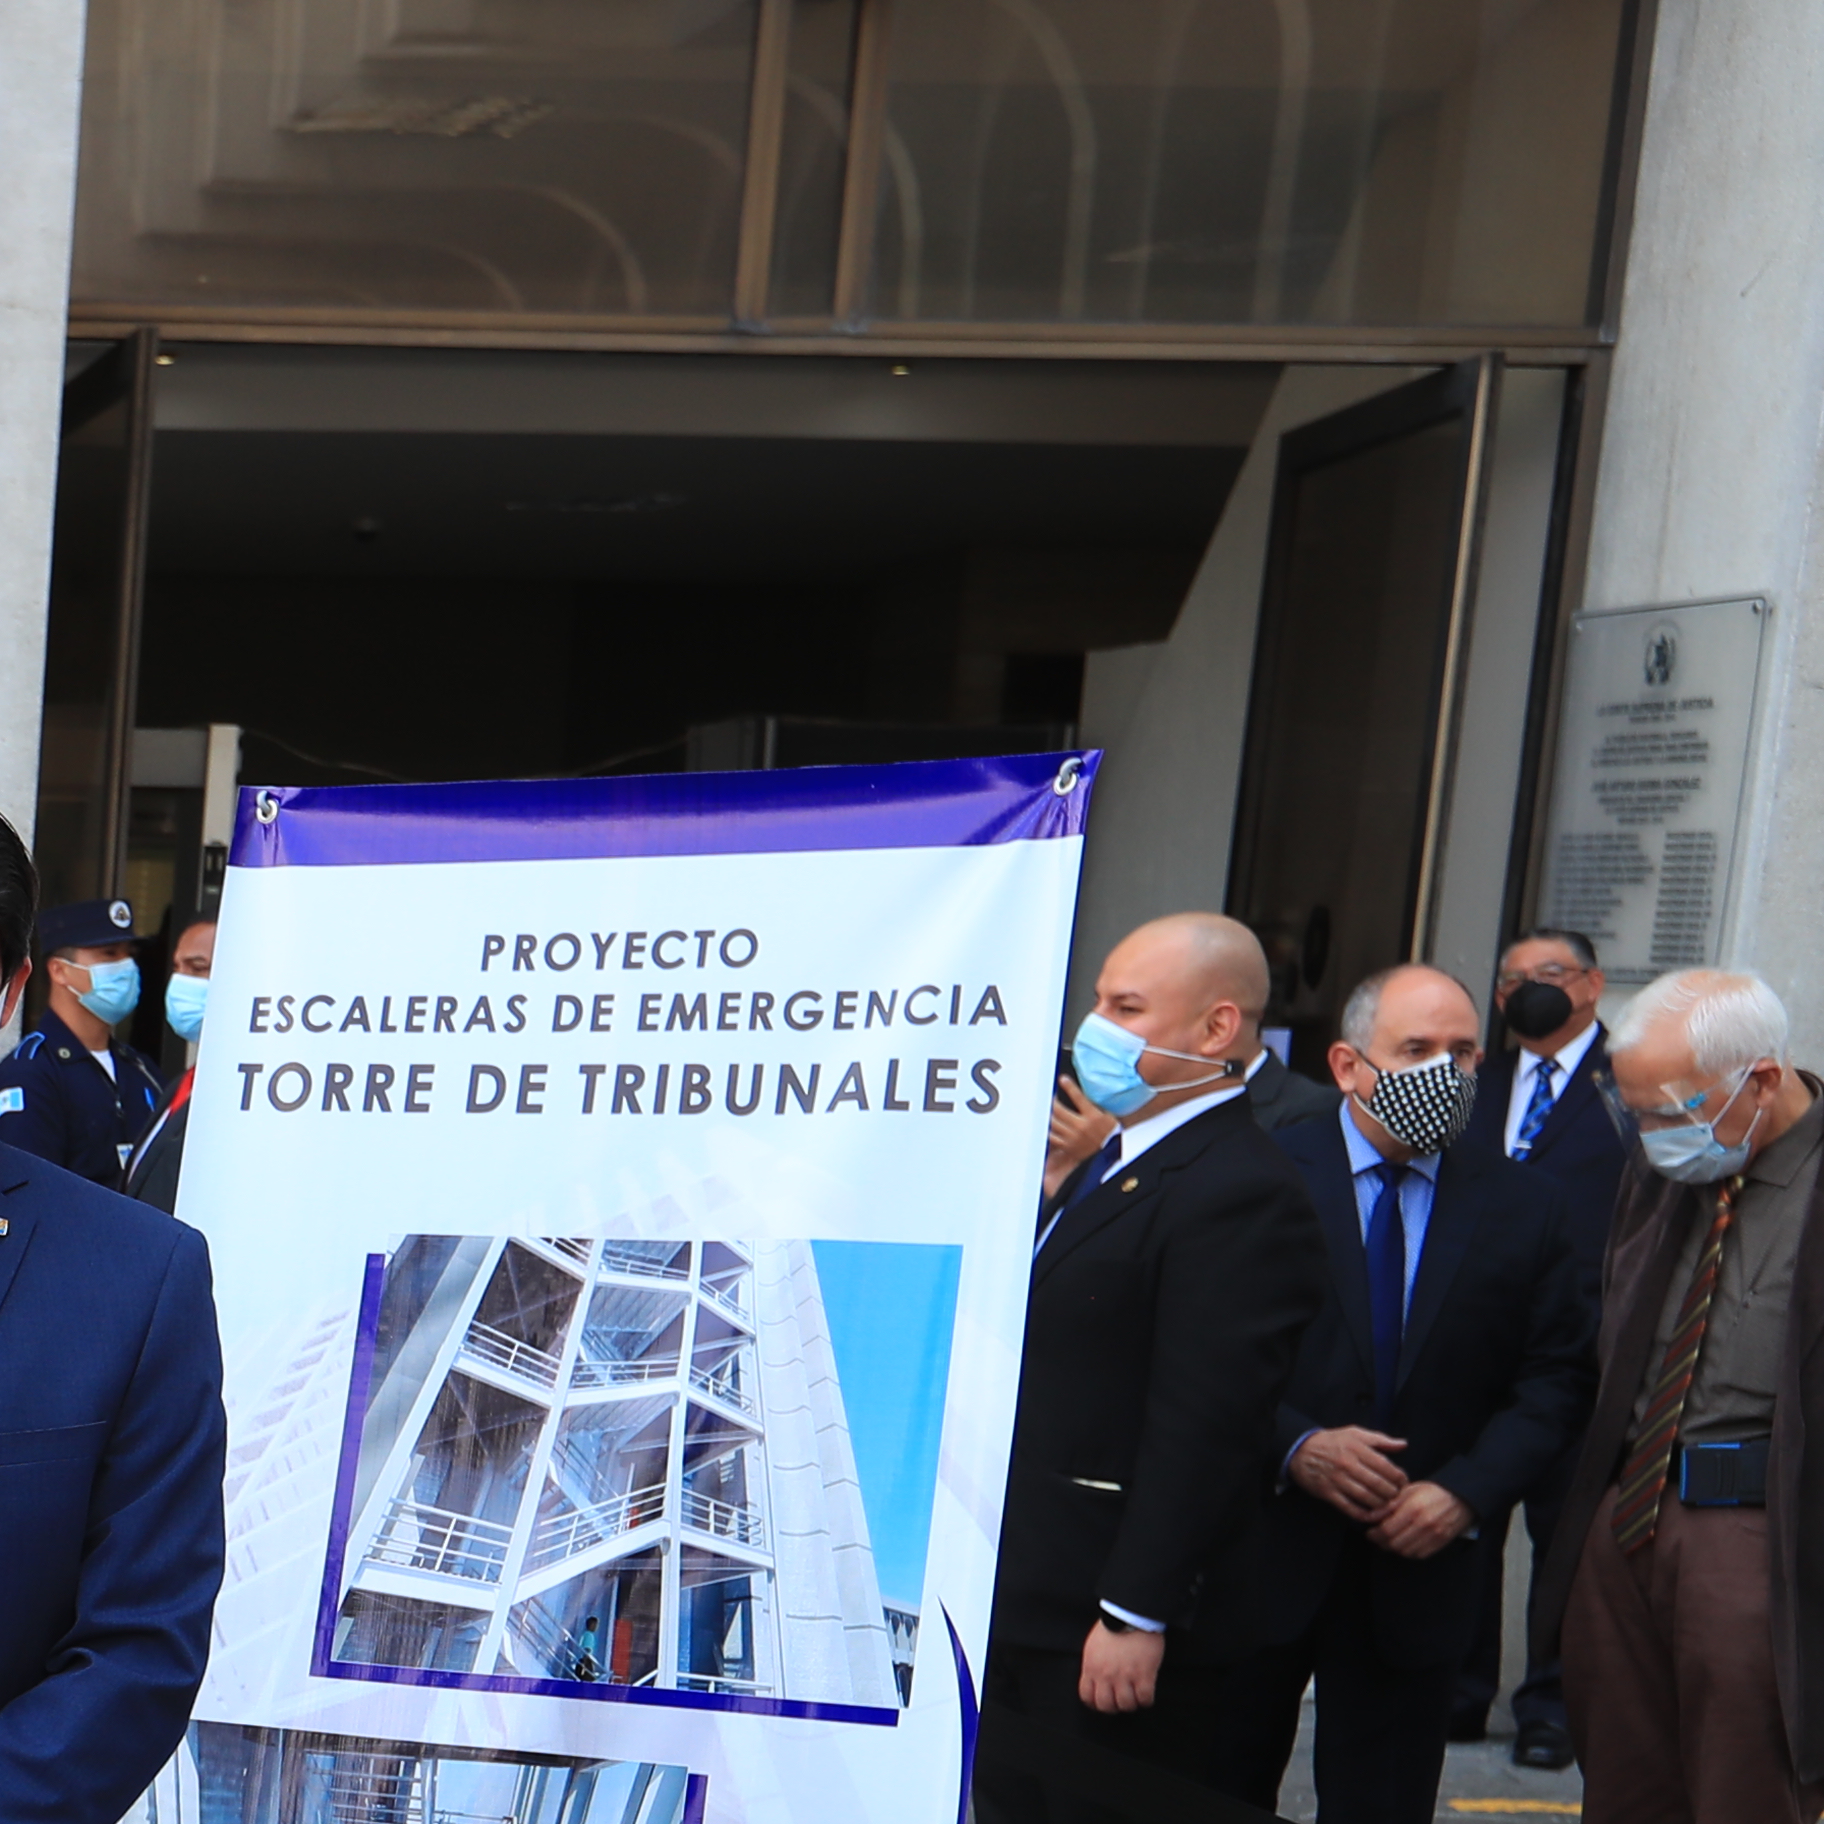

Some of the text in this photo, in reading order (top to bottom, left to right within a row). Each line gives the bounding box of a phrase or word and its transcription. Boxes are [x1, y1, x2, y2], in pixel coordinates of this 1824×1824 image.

[481, 927, 760, 972] PROYECTO
[249, 984, 1010, 1034] ESCALERAS DE EMERGENCIA
[236, 1058, 1004, 1117] TORRE DE TRIBUNALES
